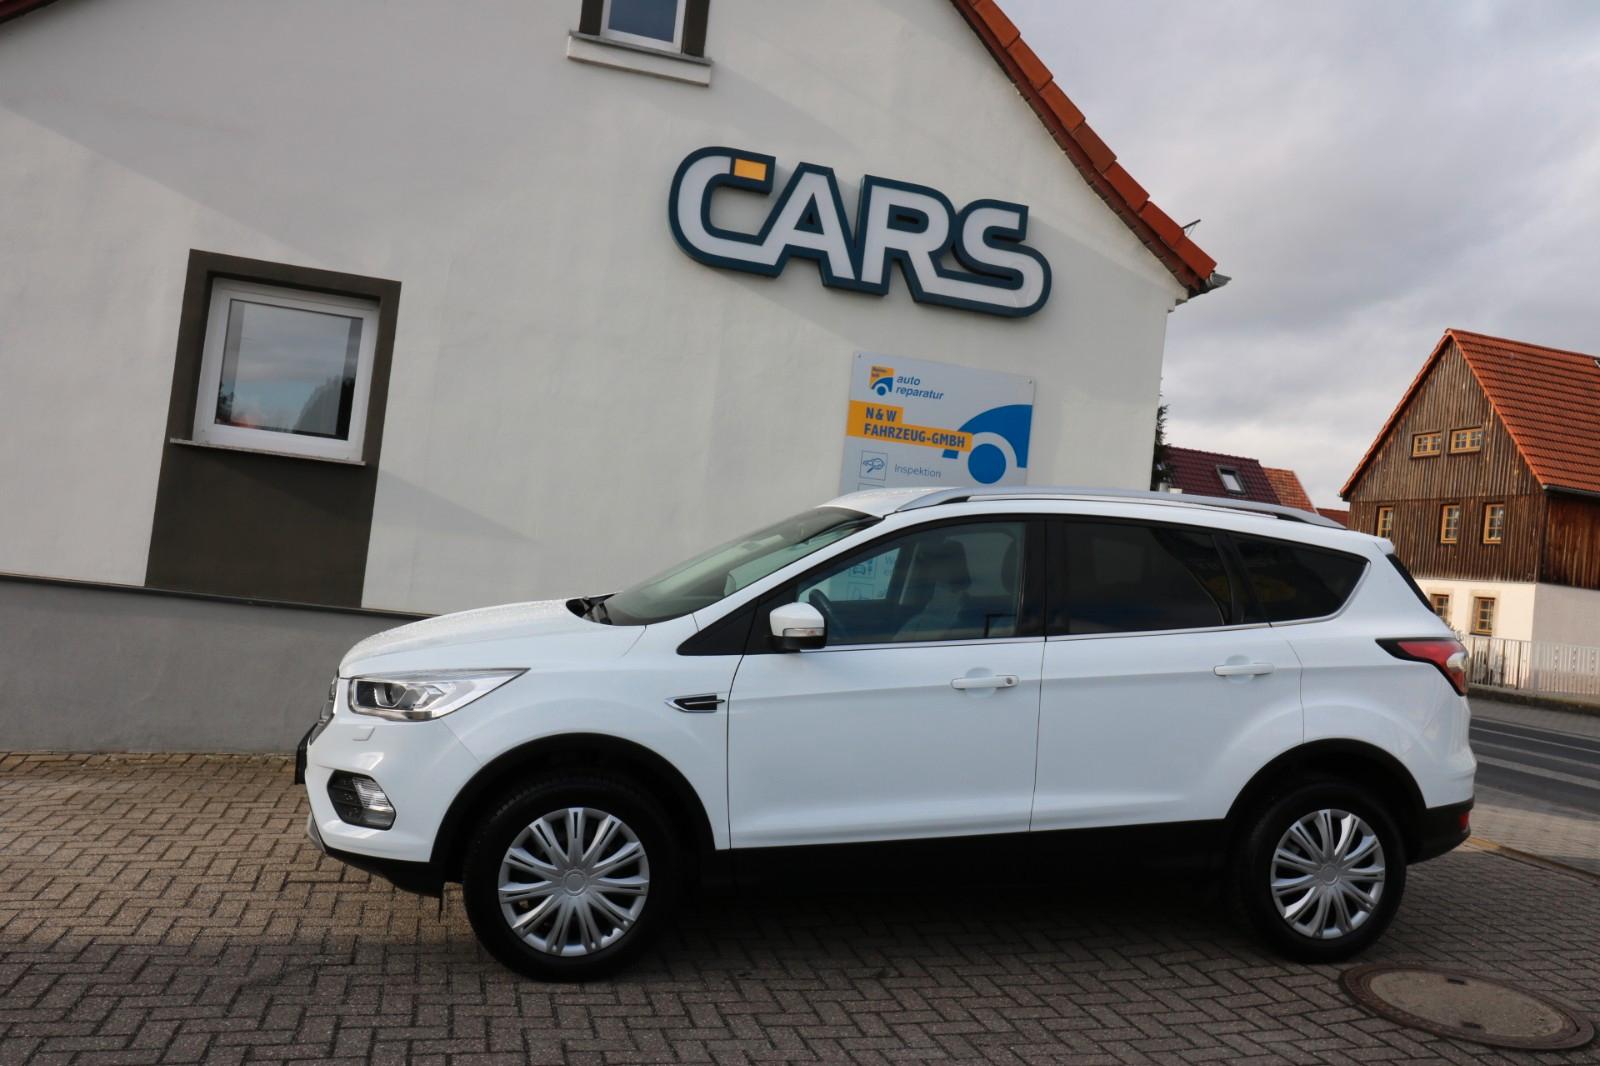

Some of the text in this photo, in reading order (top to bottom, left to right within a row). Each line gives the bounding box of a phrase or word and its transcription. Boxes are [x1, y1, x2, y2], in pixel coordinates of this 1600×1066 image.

[670, 147, 1050, 317] CARS
[896, 375, 921, 386] auto
[896, 386, 944, 400] reparatur
[864, 423, 965, 448] FAHRZEUG-GMBH
[894, 463, 942, 478] Inspektion
